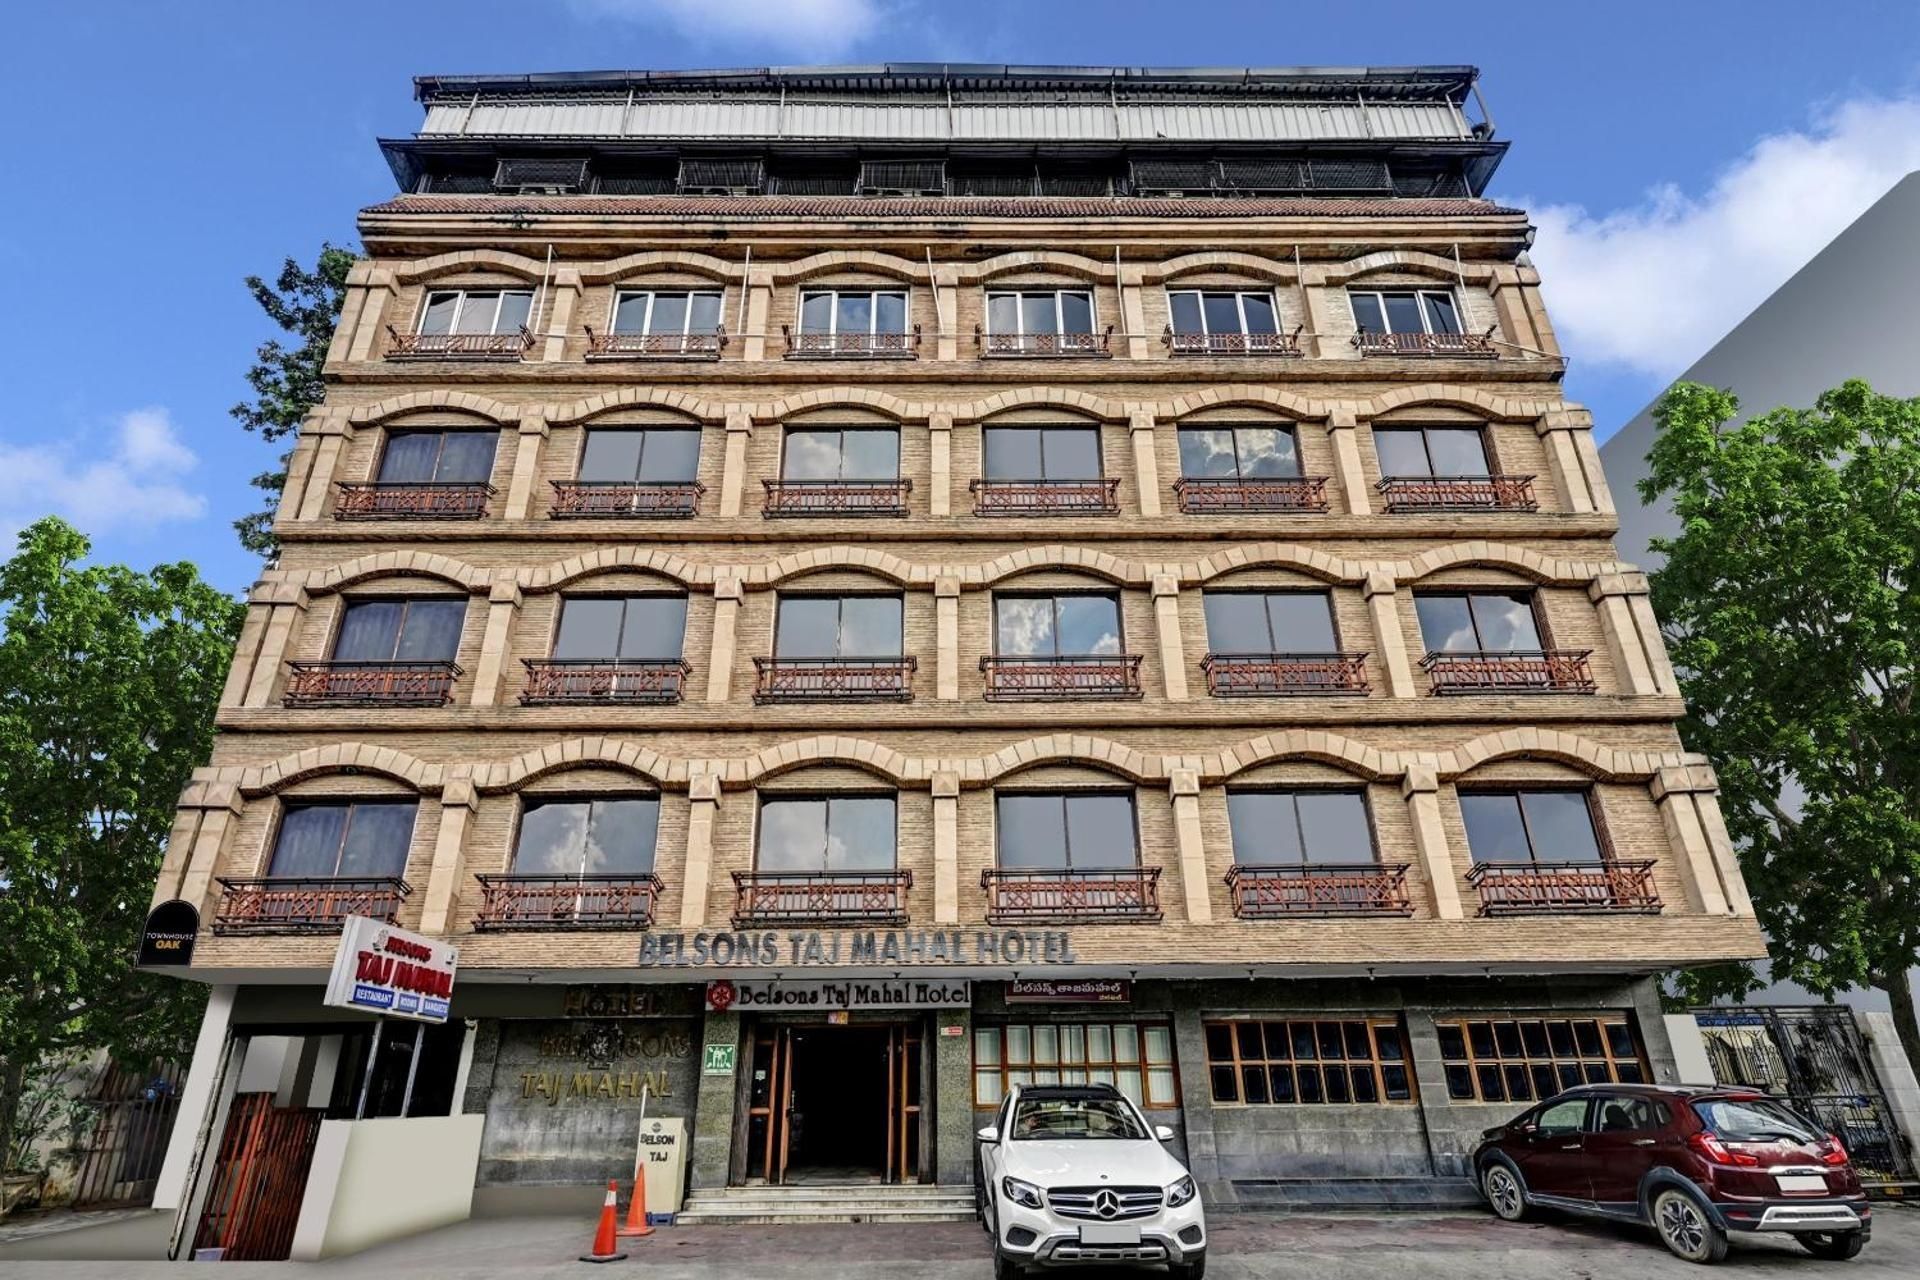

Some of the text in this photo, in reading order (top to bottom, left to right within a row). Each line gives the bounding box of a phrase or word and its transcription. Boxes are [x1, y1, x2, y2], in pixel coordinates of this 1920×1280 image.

[146, 932, 194, 940] TOWNHOUSE
[156, 940, 182, 950] OAK
[638, 930, 1076, 965] BELSONS TAJ MAHAL HOTEL
[356, 950, 394, 985] TAJ
[739, 981, 970, 1007] Belsons Taj Mahal Hotel
[520, 1071, 673, 1107] TAJ MAHAL
[640, 1133, 675, 1145] BELSON
[650, 1151, 668, 1161] TAJ
